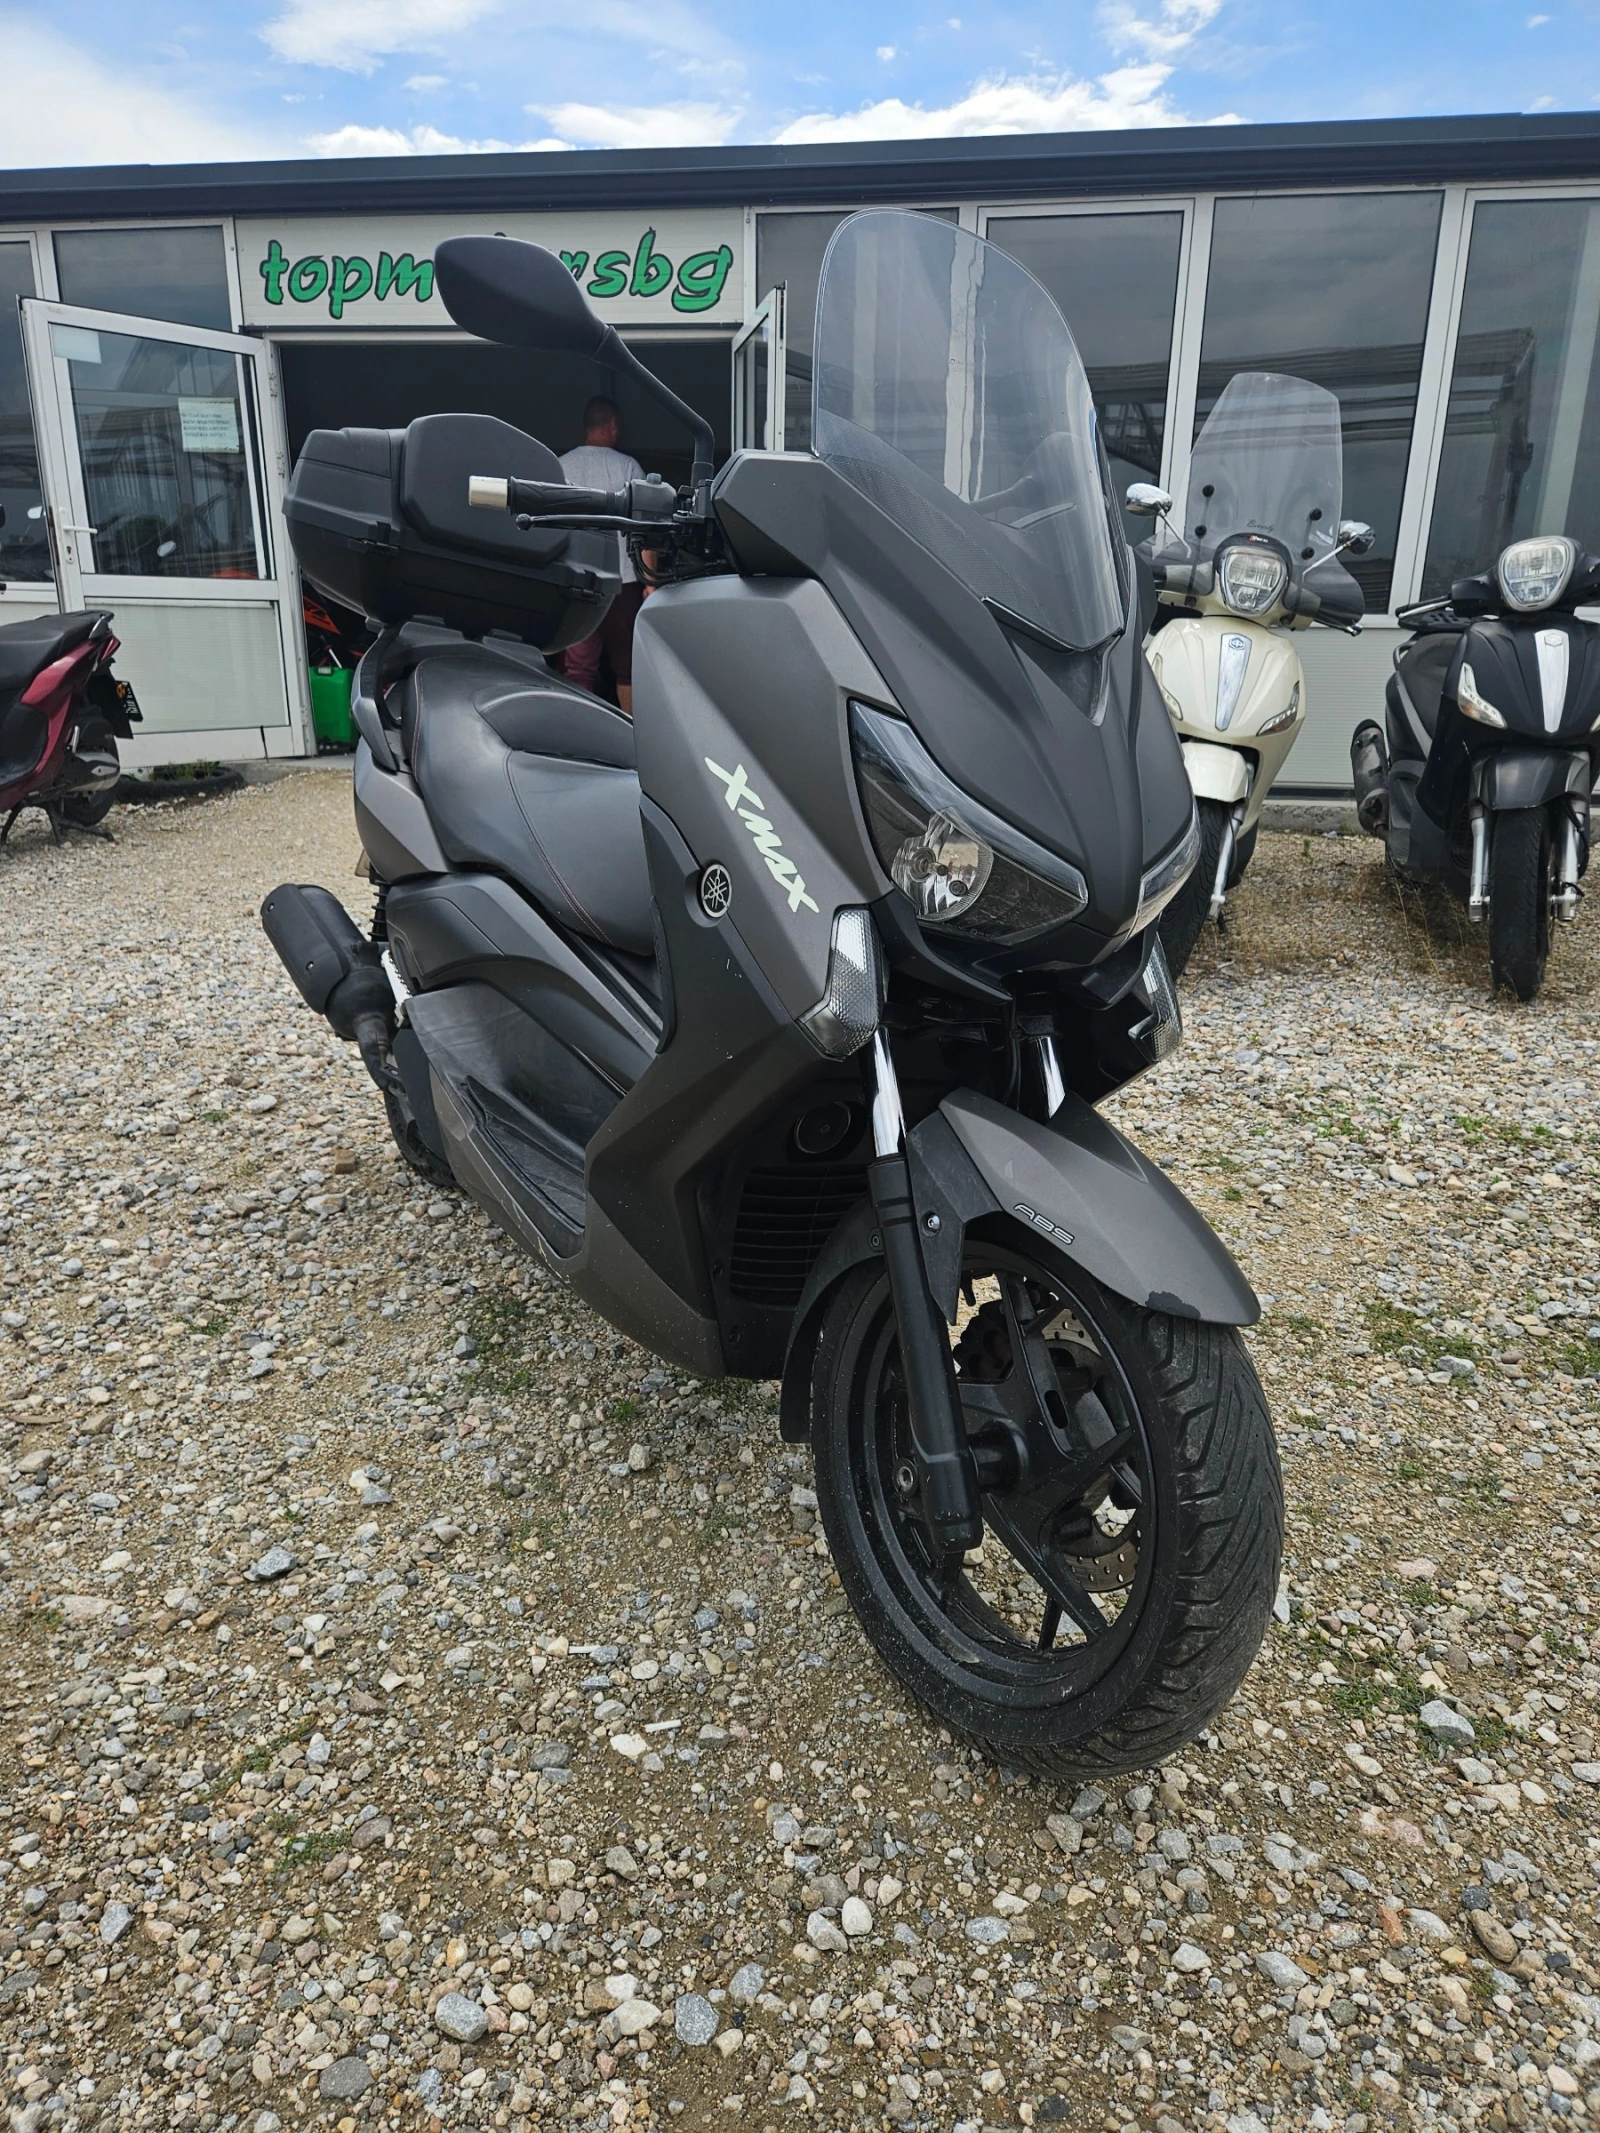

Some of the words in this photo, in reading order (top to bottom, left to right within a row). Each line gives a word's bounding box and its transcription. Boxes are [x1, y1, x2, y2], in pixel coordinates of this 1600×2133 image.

[260, 227, 733, 319] topmrsbg
[704, 757, 820, 913] XMAX
[1014, 1203, 1075, 1245] ABS
